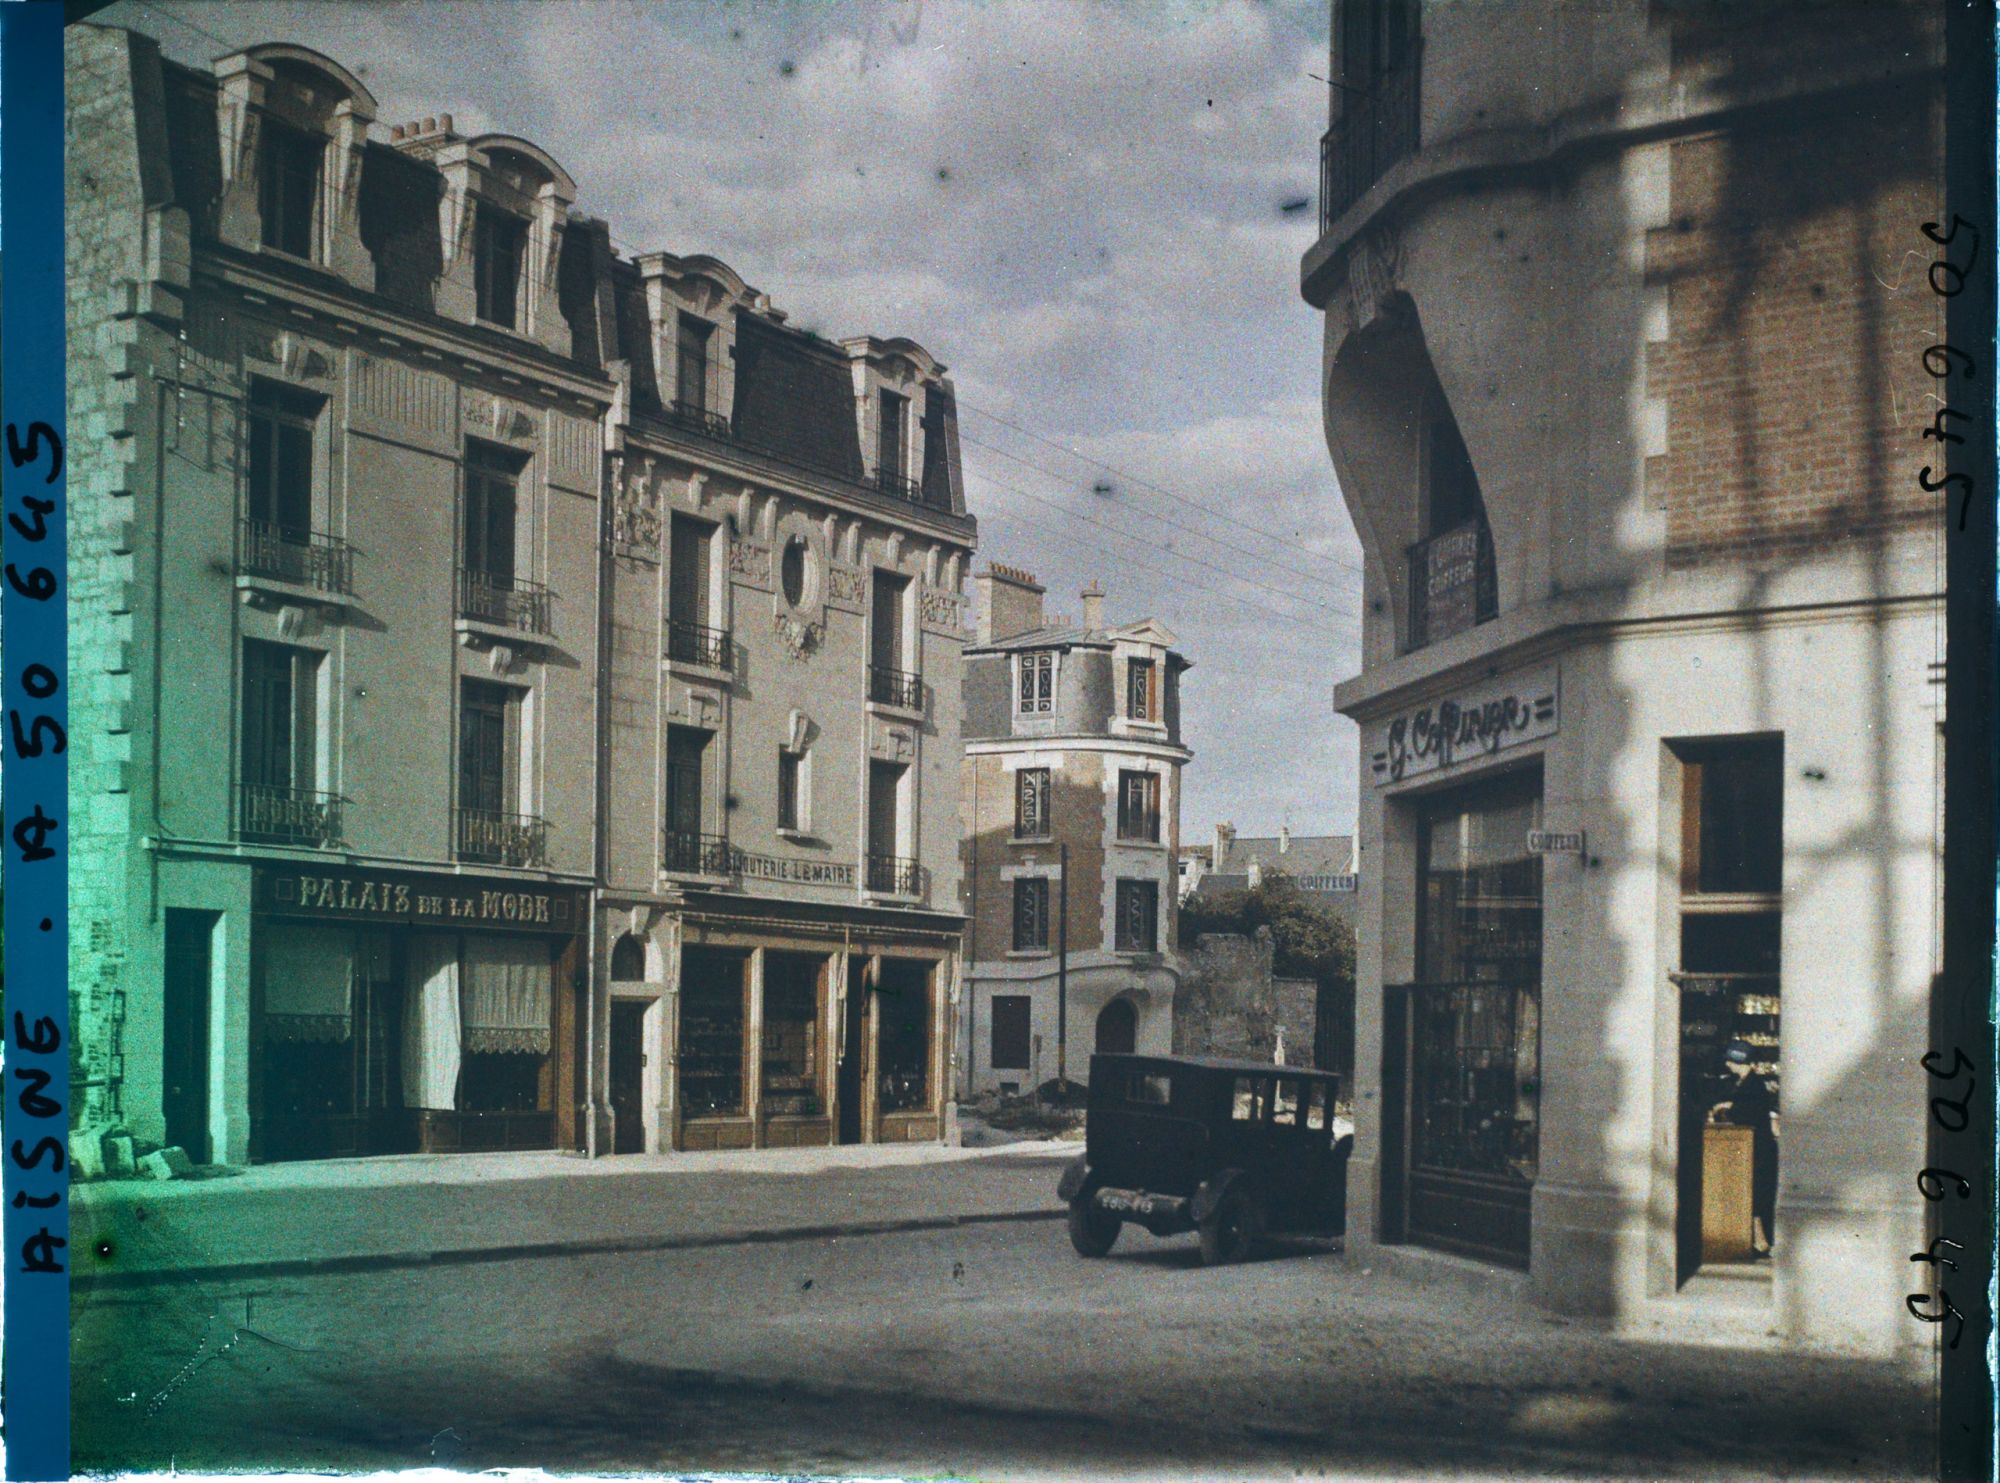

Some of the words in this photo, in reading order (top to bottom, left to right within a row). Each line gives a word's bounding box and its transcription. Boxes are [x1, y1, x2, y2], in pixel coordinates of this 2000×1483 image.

[1920, 213, 1980, 298] 50
[7, 421, 64, 602] 645
[9, 663, 65, 760] 50
[13, 804, 59, 863] A
[794, 861, 853, 884] LEMAIRE
[300, 876, 411, 914] PALAIS
[417, 895, 443, 915] DE
[450, 897, 476, 918] LA
[482, 890, 550, 923] MODE
[1920, 1047, 1976, 1133] 50
